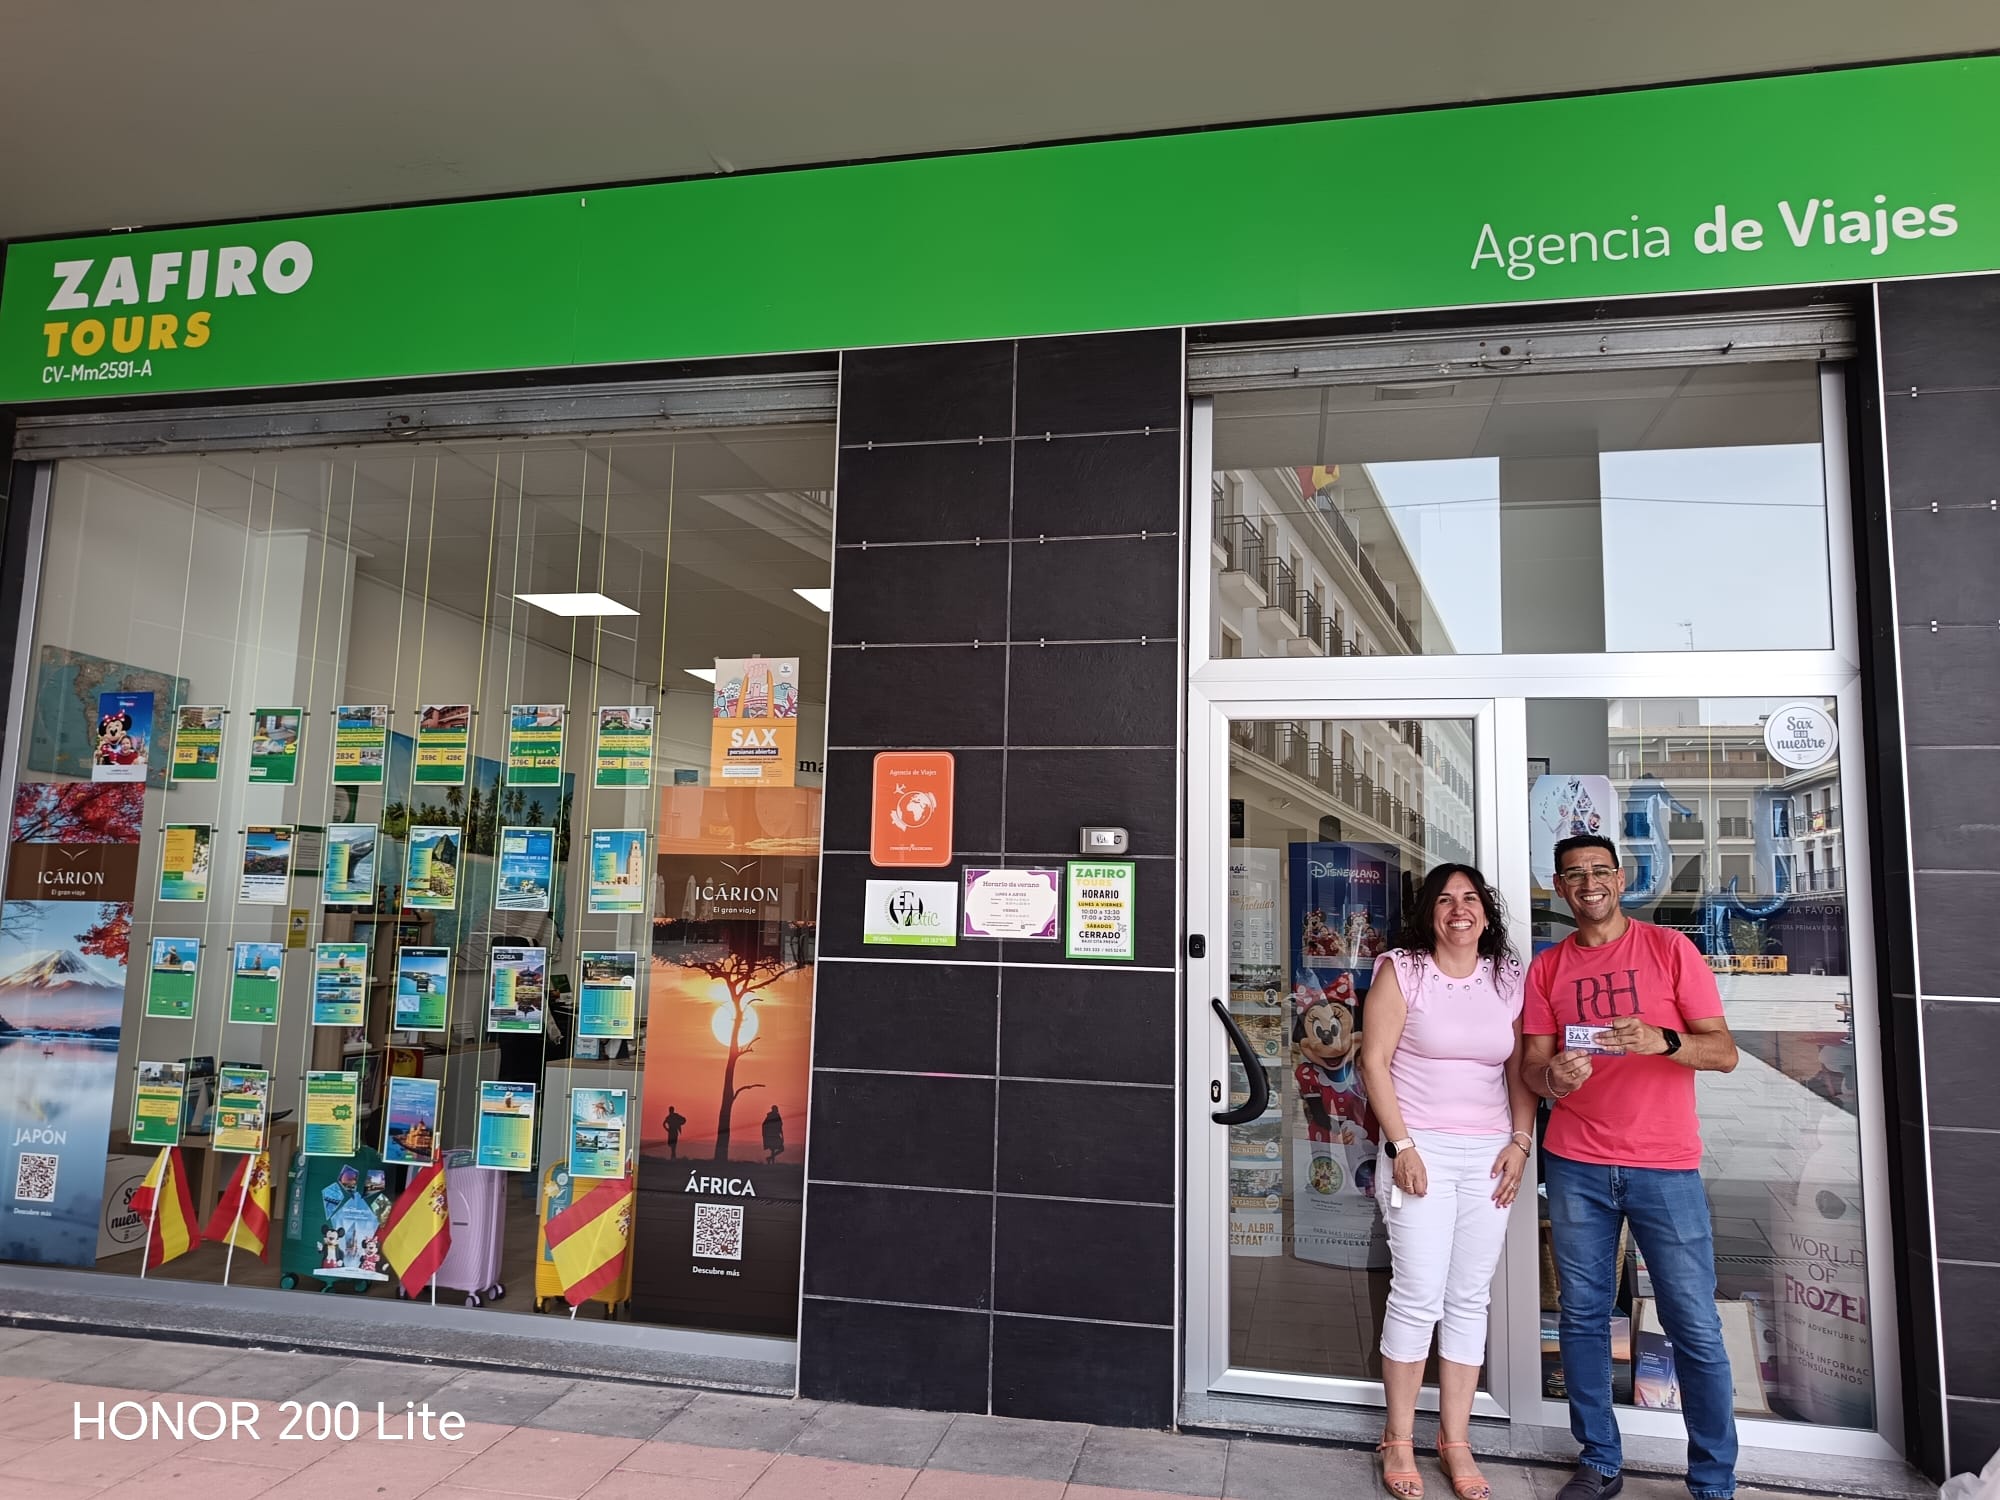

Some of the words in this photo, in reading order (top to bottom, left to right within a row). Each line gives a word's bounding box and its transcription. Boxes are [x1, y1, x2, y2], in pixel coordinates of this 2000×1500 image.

[1471, 215, 1671, 281] Agencia
[1694, 205, 1764, 254] de
[1778, 194, 1959, 256] Viajes
[46, 240, 314, 311] ZAFIRO
[43, 312, 212, 358] TOURS
[42, 359, 152, 384] CV-Mm2591-A
[1787, 716, 1813, 731] Sax
[731, 728, 777, 747] SAX
[1777, 738, 1826, 749] nuestro
[38, 868, 104, 885] ICÁRION
[1075, 868, 1126, 878] ZAFIRO
[695, 883, 779, 901] ICÁRION
[1082, 889, 1119, 899] HORARIO
[1079, 931, 1121, 939] CERRADO
[1569, 1032, 1589, 1040] SAX
[12, 1125, 67, 1146] JAPÓN
[685, 1170, 756, 1197] ÁFRICA
[1248, 1223, 1274, 1233] ALBIR
[1790, 1233, 1864, 1265] WORLD
[692, 1265, 725, 1276] Descubre
[726, 1269, 740, 1277] más
[1808, 1264, 1838, 1283] OF
[1808, 1322, 1855, 1342] ADVENTURE
